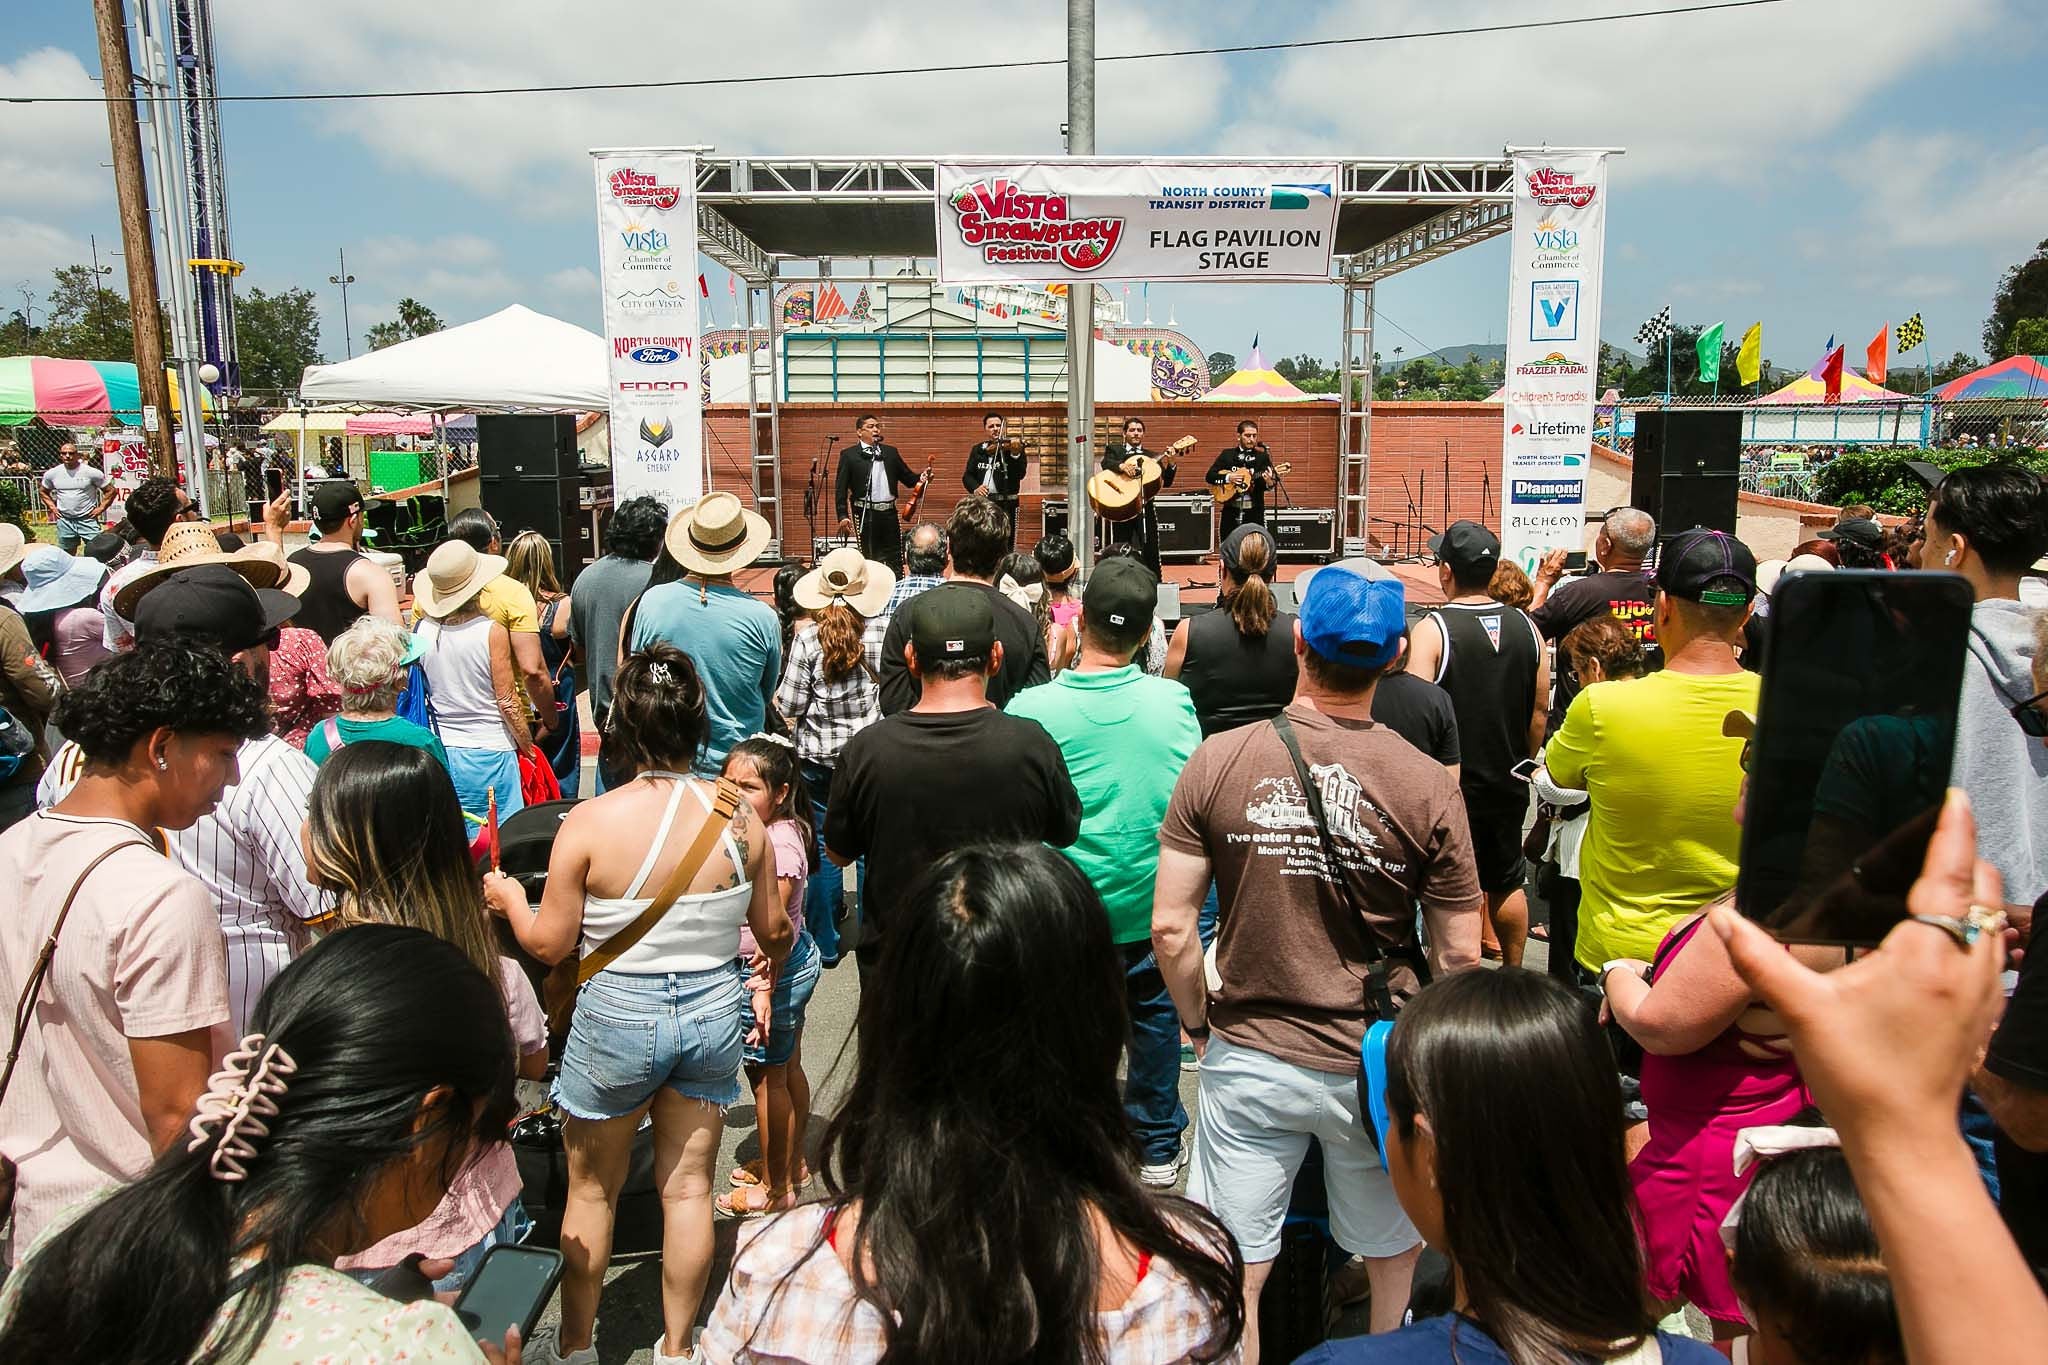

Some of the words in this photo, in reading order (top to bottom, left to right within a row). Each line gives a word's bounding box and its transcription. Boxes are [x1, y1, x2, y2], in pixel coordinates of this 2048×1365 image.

[1162, 187, 1208, 197] NORTH
[1213, 187, 1266, 197] COUNTY
[972, 179, 1067, 221] Vista
[1150, 200, 1204, 210] TRANSIT
[1208, 200, 1266, 209] DISTRICT
[1150, 231, 1208, 248] FLAG
[1214, 230, 1321, 247] PAVILION
[987, 246, 1057, 261] Festival
[622, 262, 672, 271] Commerce
[1199, 252, 1269, 269] STAGE
[1531, 261, 1580, 269] Commerce
[614, 337, 650, 358] NORTH
[653, 336, 692, 357] COUNTY
[639, 348, 671, 361] Ford
[1516, 367, 1557, 375] FRAZIER
[1529, 422, 1586, 435] Lifetime
[637, 449, 680, 462] ASGARD
[1515, 481, 1581, 494] Diamond
[1227, 833, 1250, 844] I've
[1252, 832, 1290, 843] eaten
[1294, 835, 1321, 846] and
